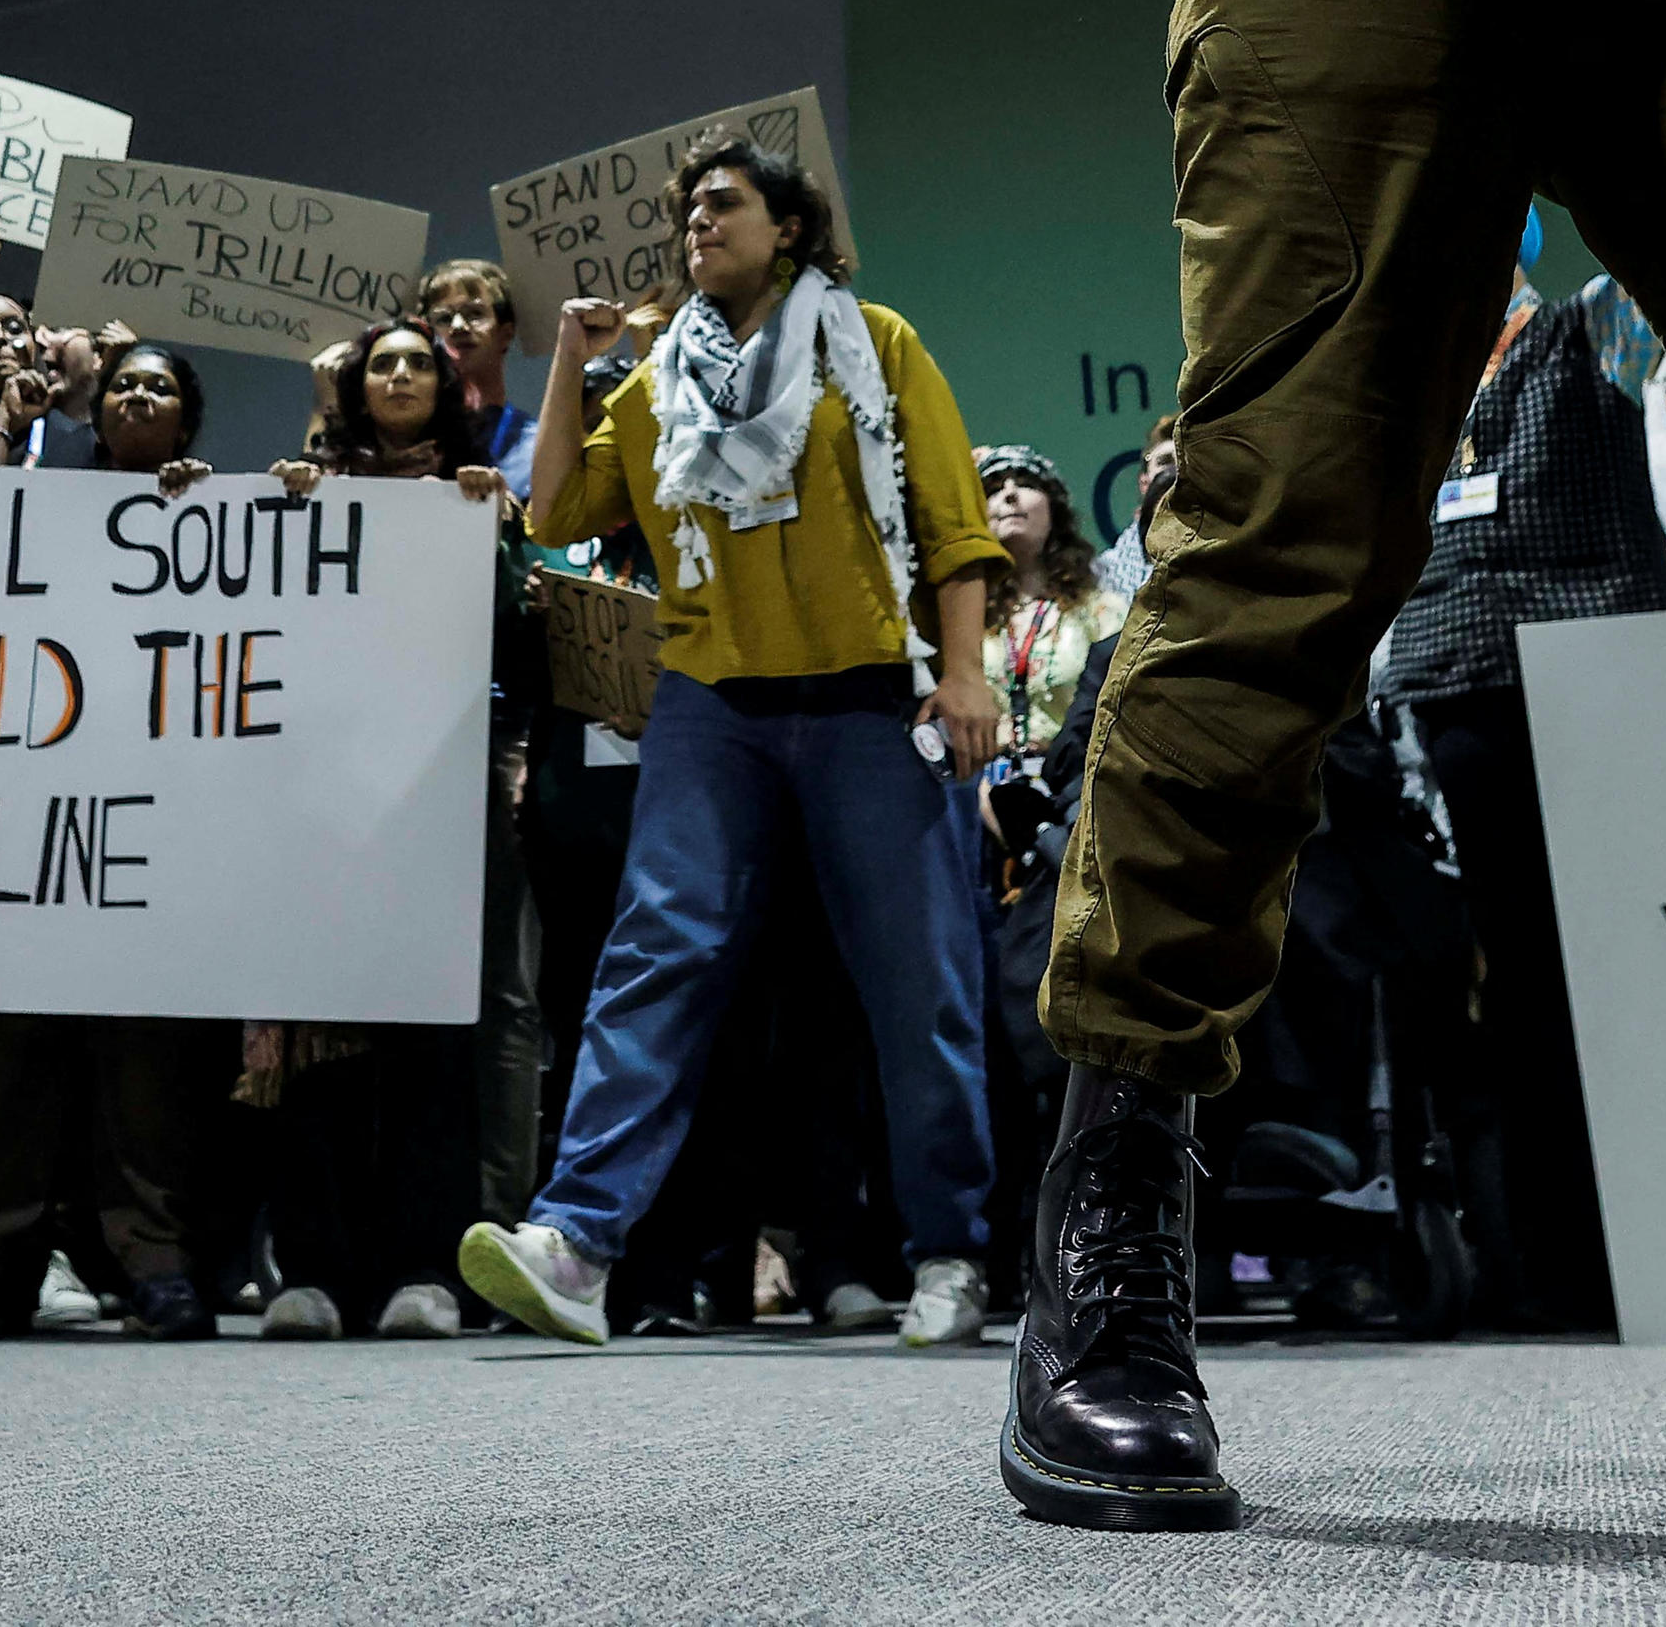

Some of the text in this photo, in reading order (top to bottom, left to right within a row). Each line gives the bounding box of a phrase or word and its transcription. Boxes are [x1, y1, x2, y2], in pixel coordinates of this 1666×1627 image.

[86, 167, 333, 233] STAND UP
[505, 153, 637, 229] STAND
[72, 201, 404, 317] FOR TRILLIONS
[529, 214, 604, 257] FOR
[102, 257, 184, 288] NOT
[181, 282, 311, 343] BILLIONS
[104, 493, 364, 599] SOUTH
[554, 580, 630, 650] STOP
[133, 628, 284, 740] THE
